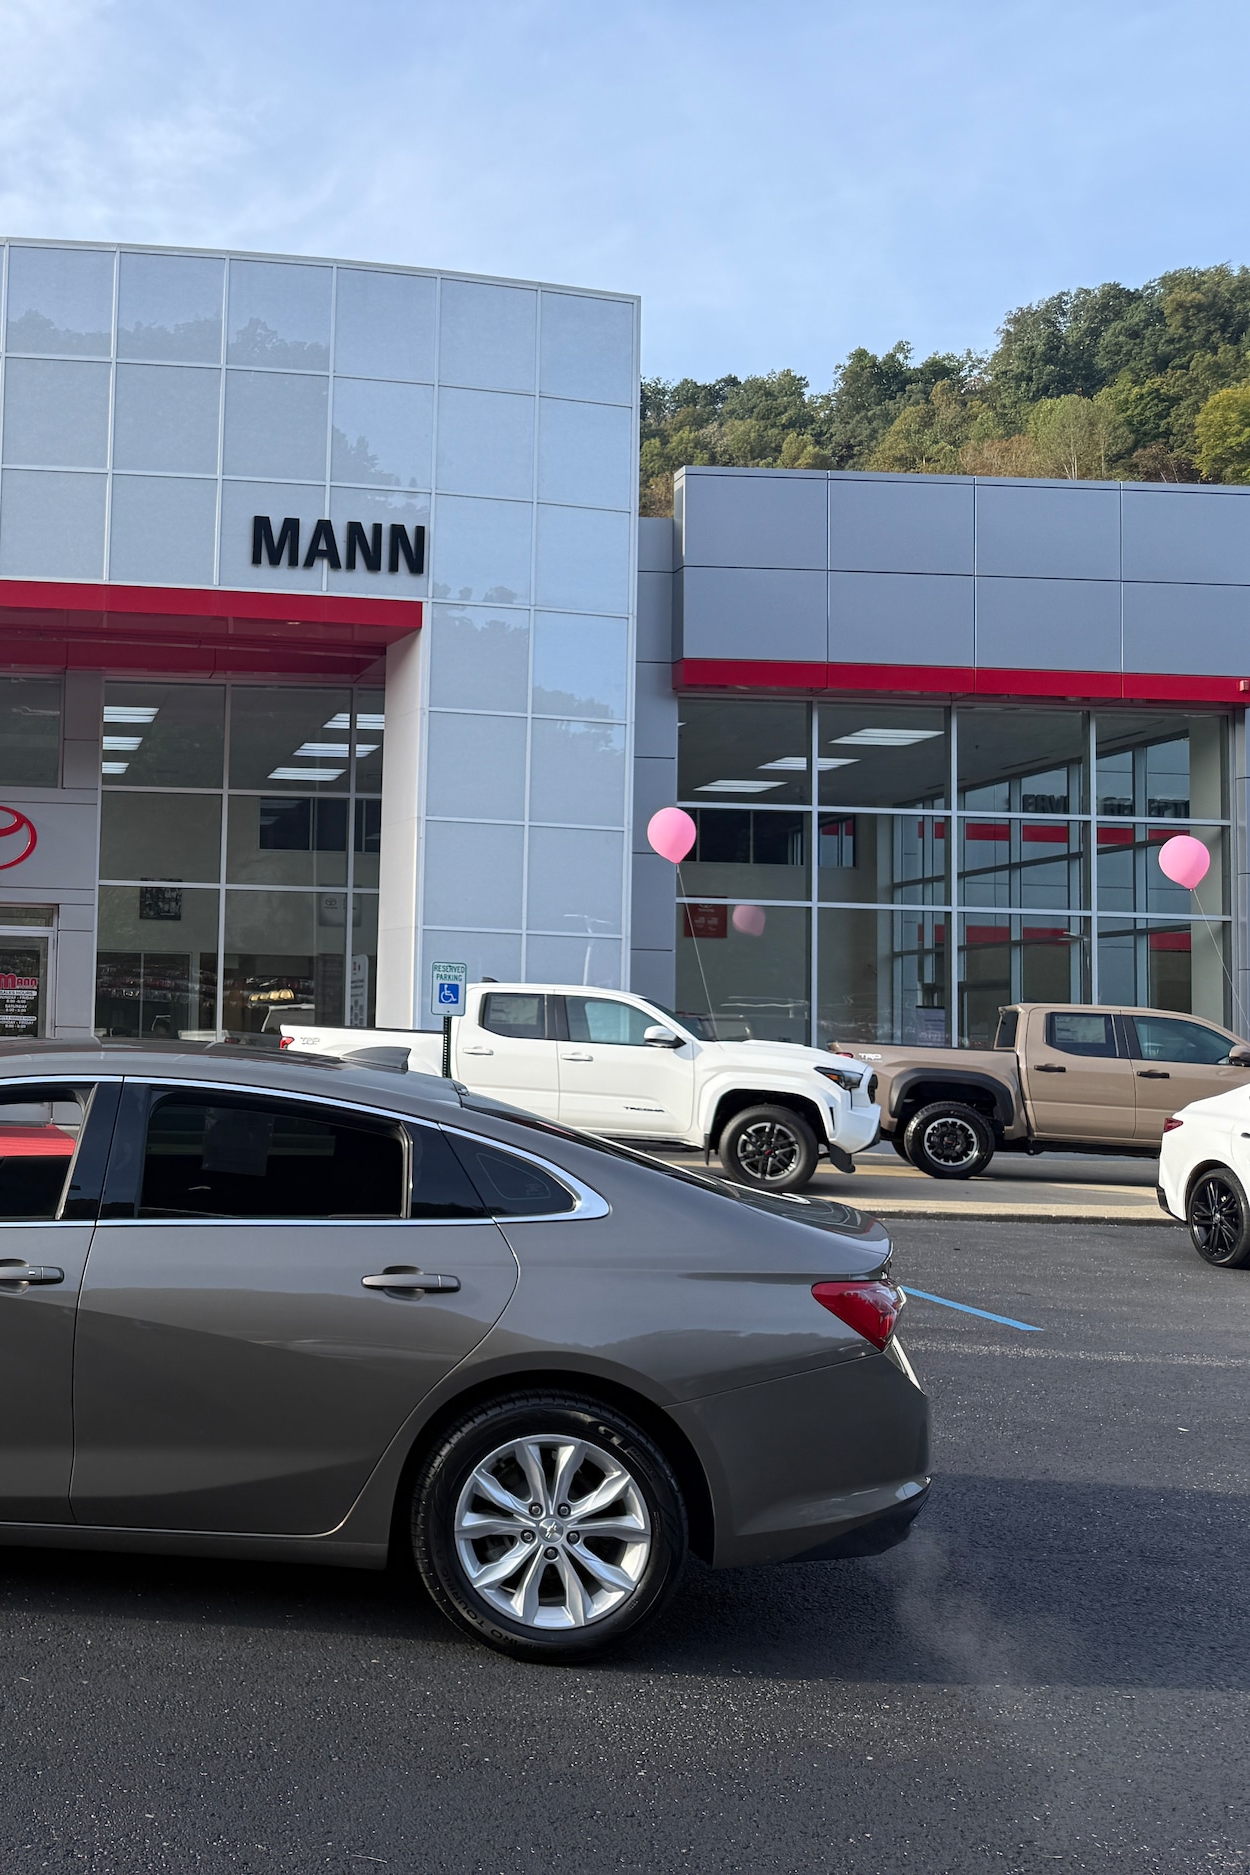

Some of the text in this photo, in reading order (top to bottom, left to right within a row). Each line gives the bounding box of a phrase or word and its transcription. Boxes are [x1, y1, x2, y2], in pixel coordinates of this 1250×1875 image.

[252, 515, 425, 574] MANN
[434, 965, 464, 973] RESERVED
[436, 974, 462, 982] PARKING
[622, 1105, 665, 1113] TACOMA
